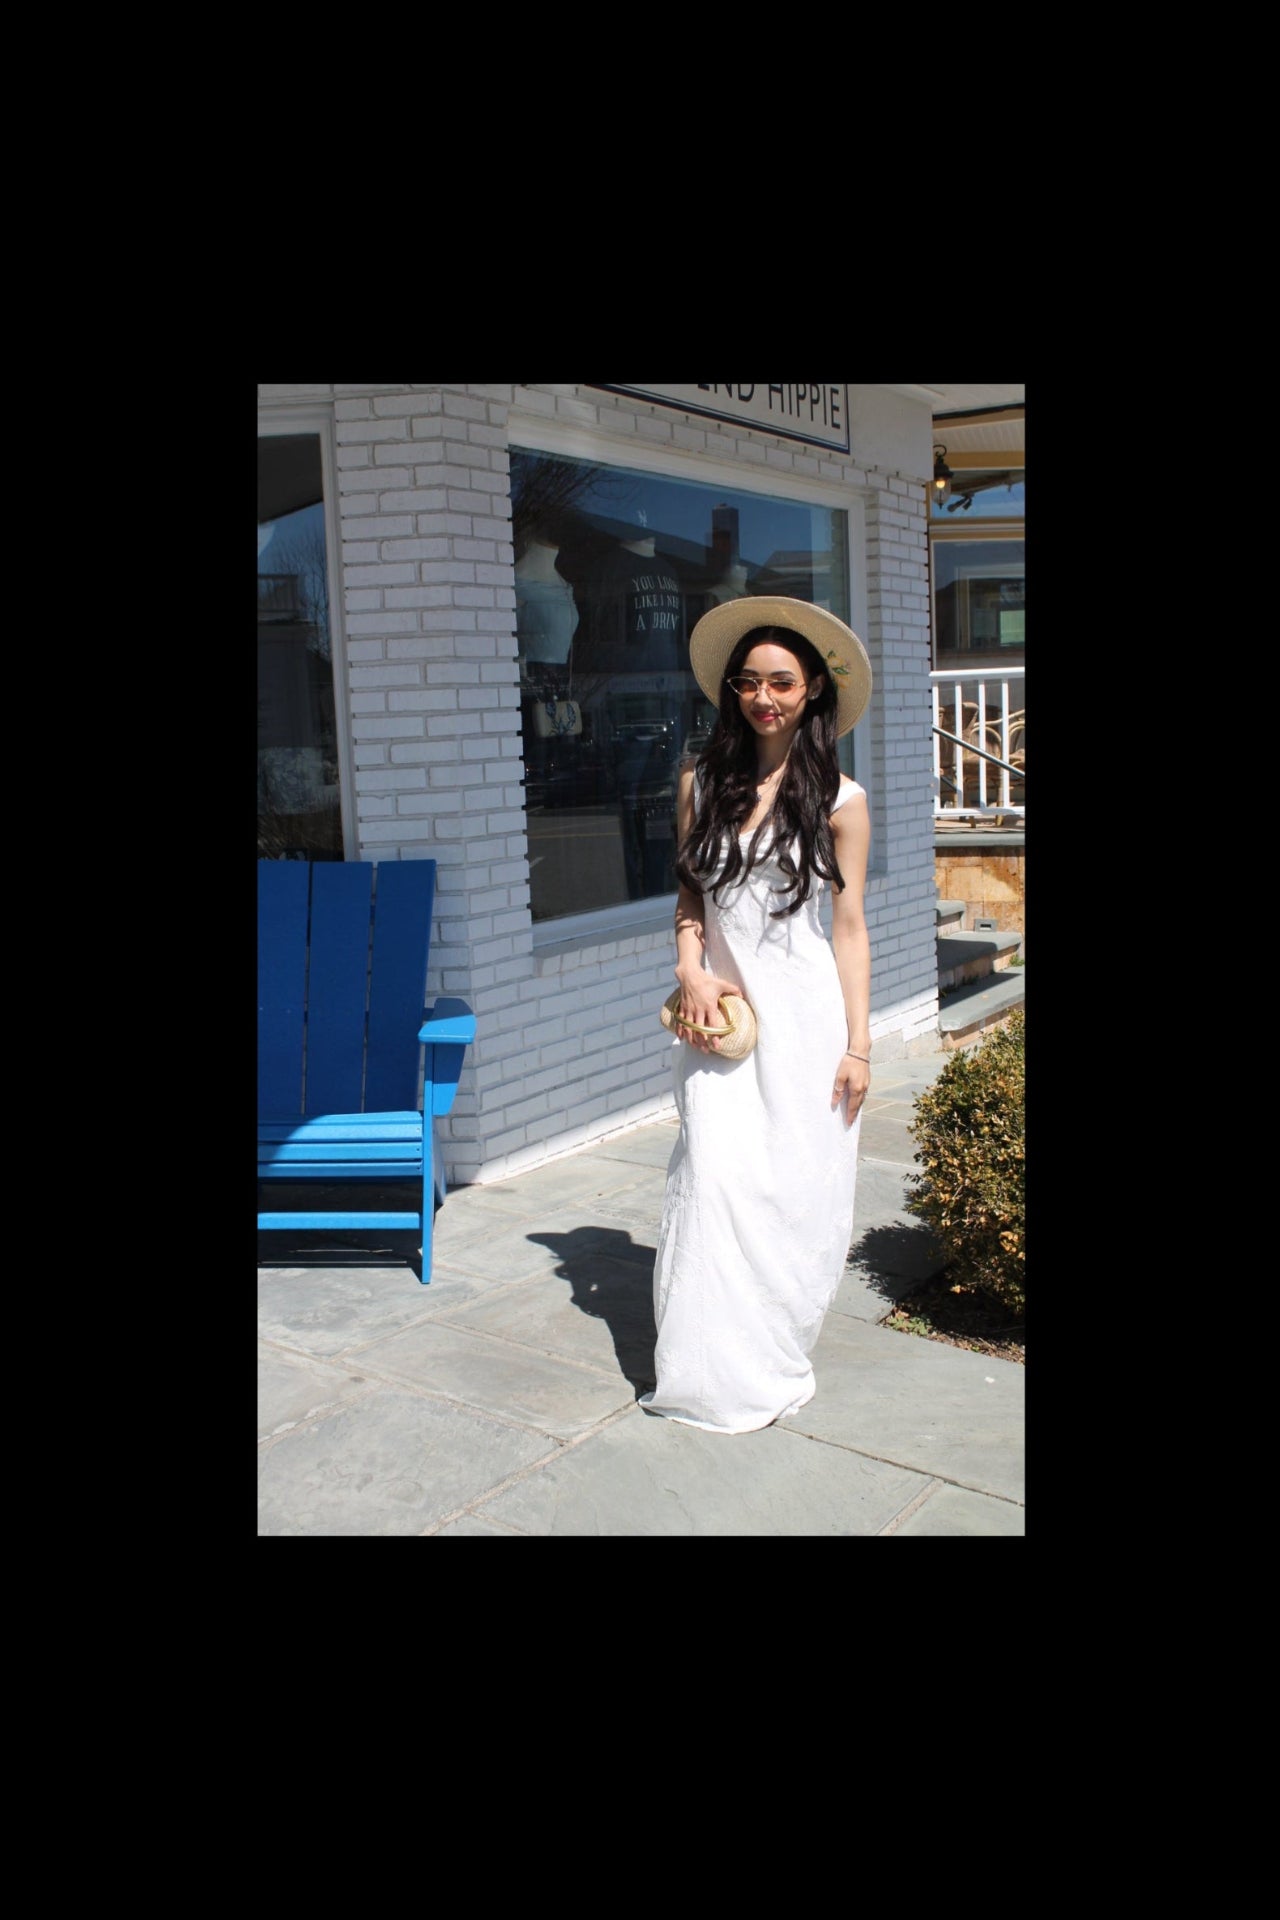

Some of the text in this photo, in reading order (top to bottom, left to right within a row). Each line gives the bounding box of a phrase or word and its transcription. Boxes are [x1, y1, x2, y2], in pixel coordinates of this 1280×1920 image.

[768, 384, 841, 429] HIPPIE
[632, 576, 655, 592] YOU
[634, 594, 659, 610] LIKE
[660, 594, 664, 606] I
[636, 612, 680, 632] A DRIN
